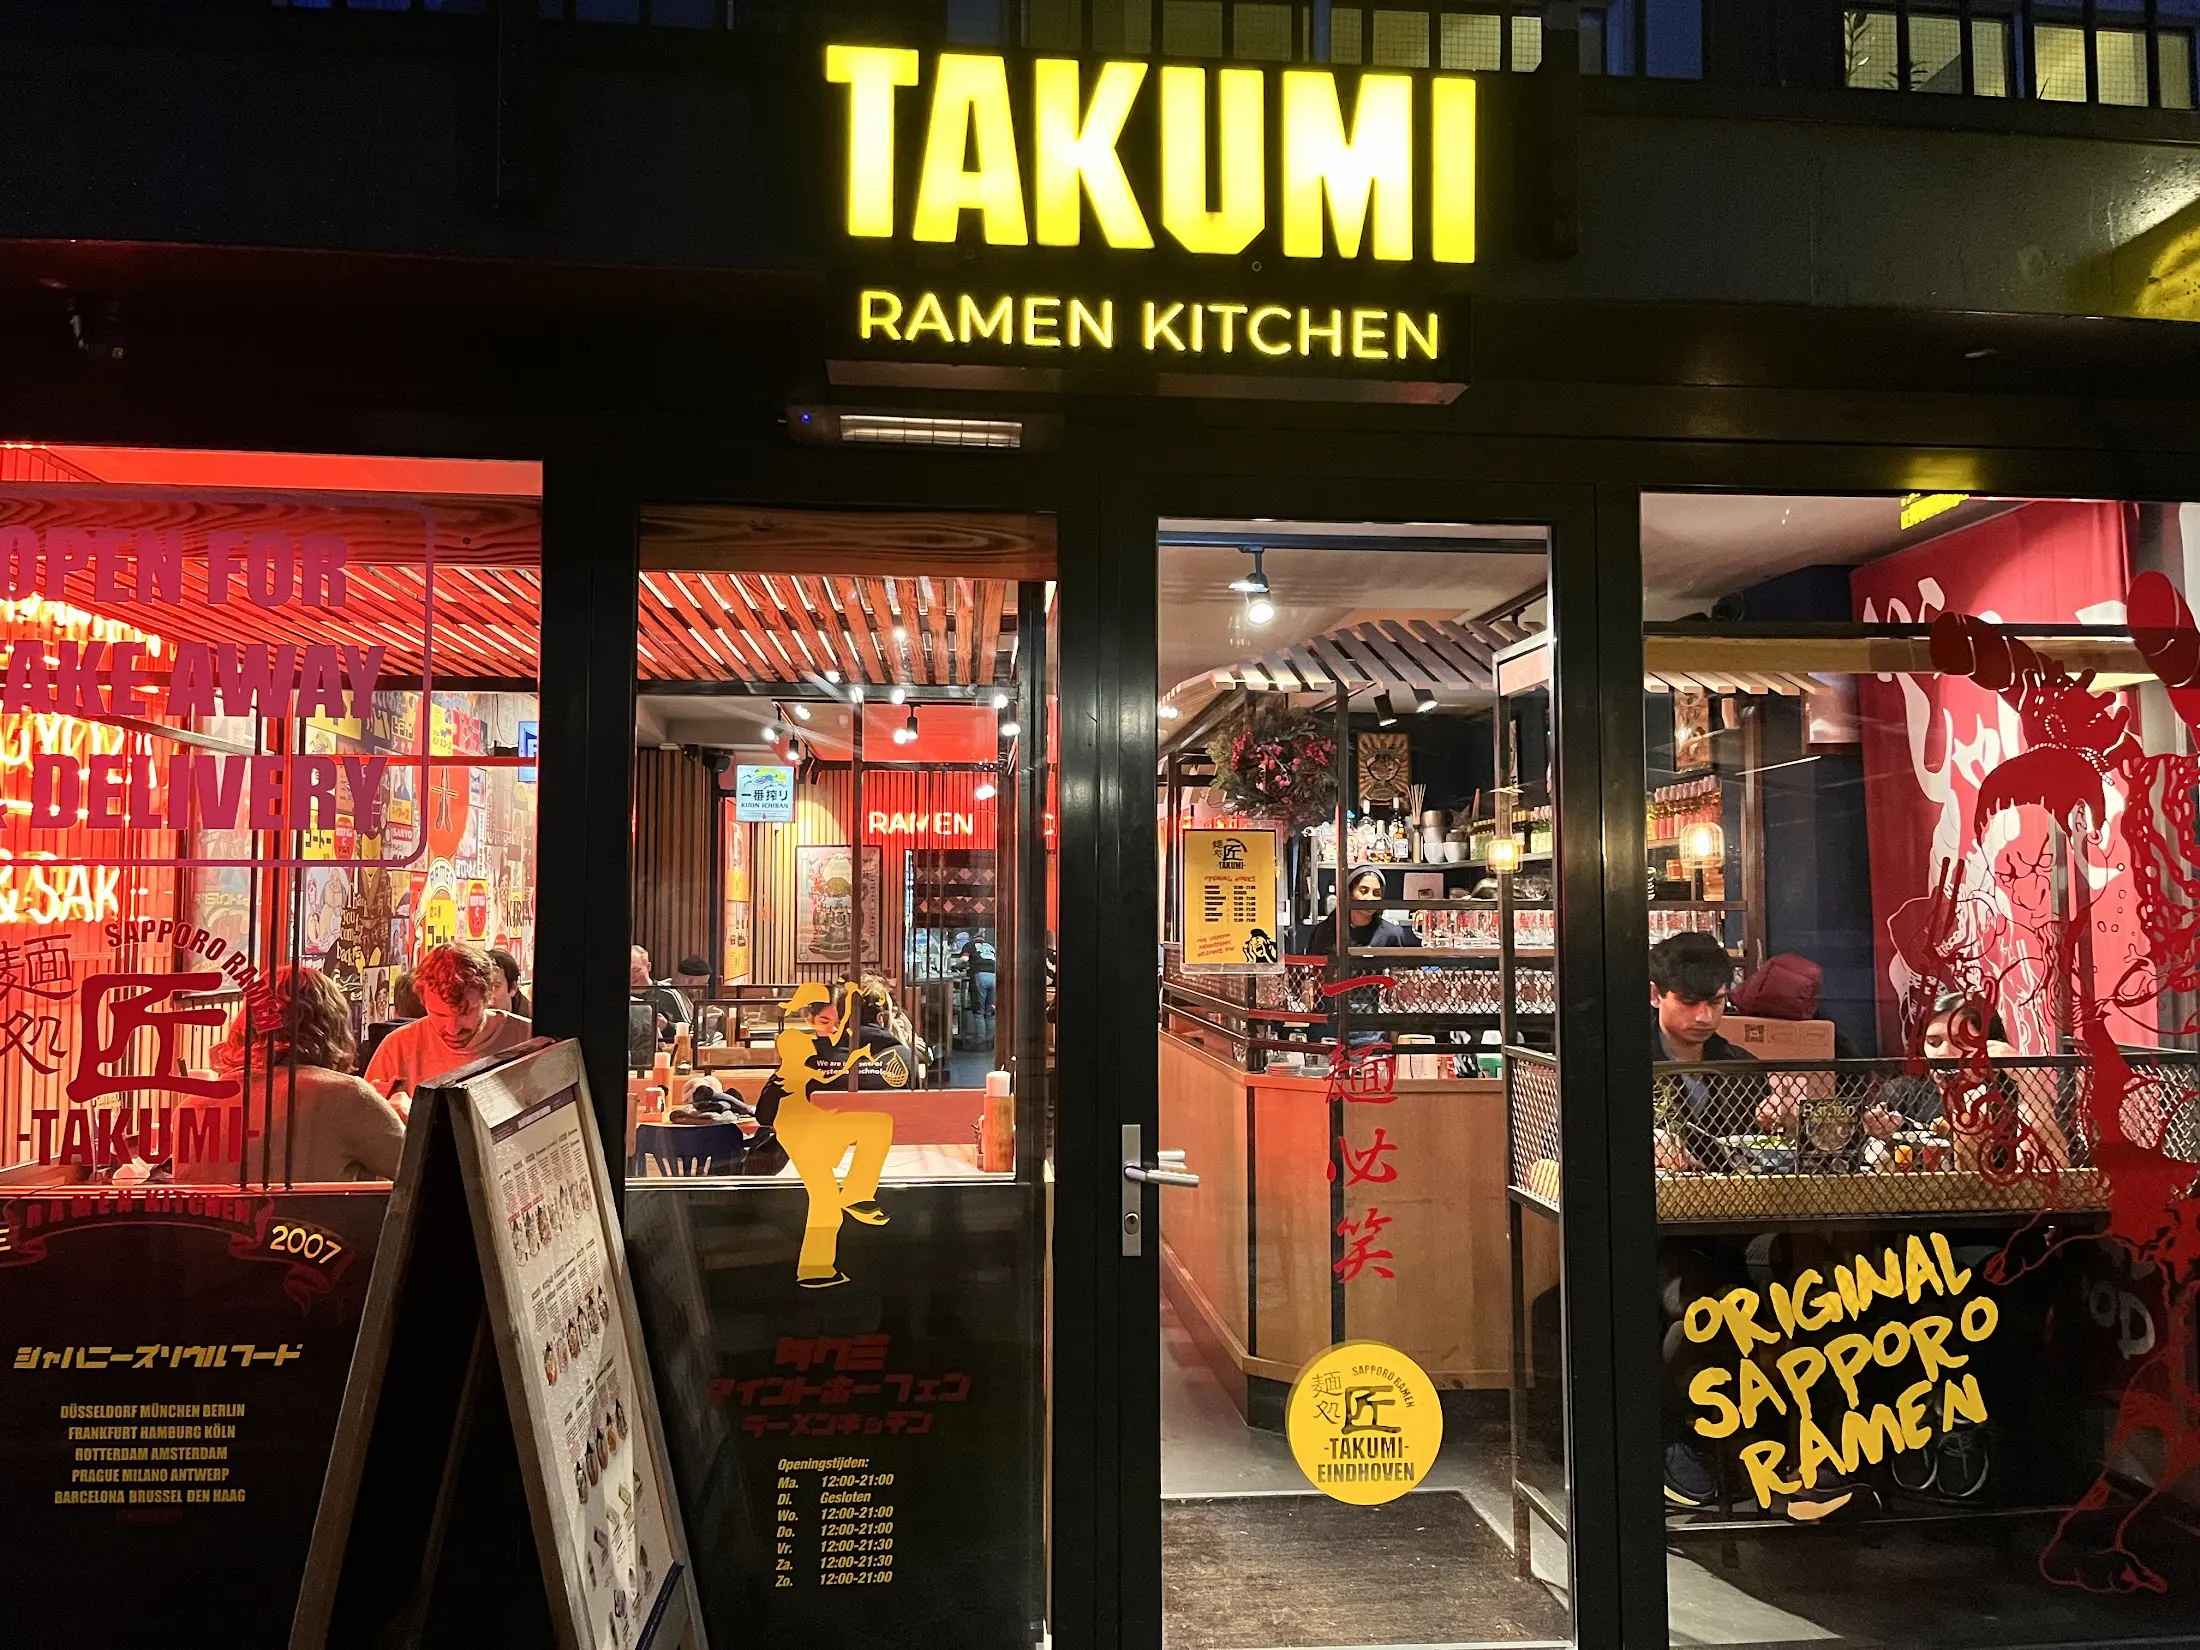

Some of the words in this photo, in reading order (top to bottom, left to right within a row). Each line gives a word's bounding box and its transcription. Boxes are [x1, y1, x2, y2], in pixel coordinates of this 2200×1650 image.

[825, 43, 1477, 265] TAKUMI
[859, 289, 1114, 350] RAMEN
[1141, 300, 1439, 360] KITCHEN
[0, 525, 183, 603] OPEN
[207, 530, 348, 608] FOR
[0, 639, 147, 715] AKE
[167, 641, 386, 717] AWAY
[33, 754, 386, 830] DELIVERY
[741, 789, 788, 801] 一番搾り
[868, 811, 974, 835] RAMEN
[392, 828, 413, 840] SANYO
[104, 919, 227, 962] SAPPORO
[222, 950, 285, 1034] RAMEN
[66, 971, 241, 1103] 匠
[270, 1225, 342, 1264] 2007
[1683, 1232, 1972, 1357] ORIGINAL
[1688, 1296, 1999, 1439] SAPPORO
[1352, 1364, 1395, 1381] SAPPORO
[1393, 1377, 1416, 1408] RAMEN
[60, 1403, 138, 1419] DÜSSELDORF
[139, 1402, 200, 1418] MÜNCHEN
[202, 1403, 245, 1418] BERLIN
[1341, 1385, 1402, 1435] 匠
[68, 1426, 138, 1440] FRANKFURT
[140, 1425, 202, 1439] HAMBURG
[204, 1422, 236, 1438] KÖLN
[1739, 1373, 1988, 1509] RAMEN
[75, 1447, 149, 1461] ROTTERDAM
[150, 1446, 228, 1460] AMSTERDAM
[777, 1456, 870, 1473] Openingstijden:
[1317, 1462, 1415, 1483] EINDHOVEN
[71, 1468, 120, 1482] PRAGUE
[121, 1468, 168, 1482] MILANO
[170, 1467, 230, 1481] ANTWERP
[777, 1477, 799, 1489] Ma.
[821, 1474, 895, 1488] 12:00-21:00
[54, 1490, 125, 1504] BARCELONA
[128, 1489, 183, 1503] BRUSSEL
[186, 1489, 211, 1503] DEN
[212, 1488, 246, 1502] HAAG
[777, 1493, 793, 1506] Di.
[820, 1491, 872, 1504] Gesloten
[777, 1509, 799, 1522] Wo.
[820, 1506, 894, 1520] 12:00-21:00
[776, 1526, 796, 1538] Do.
[820, 1522, 894, 1537] 12:00-21:00
[776, 1542, 793, 1555] Vr.
[820, 1538, 893, 1553] 12:00-21:30
[775, 1559, 794, 1571] Za.
[820, 1554, 893, 1569] 12:00-21:30
[775, 1575, 794, 1588] Zo.
[819, 1571, 893, 1586] 12:00-21:00
